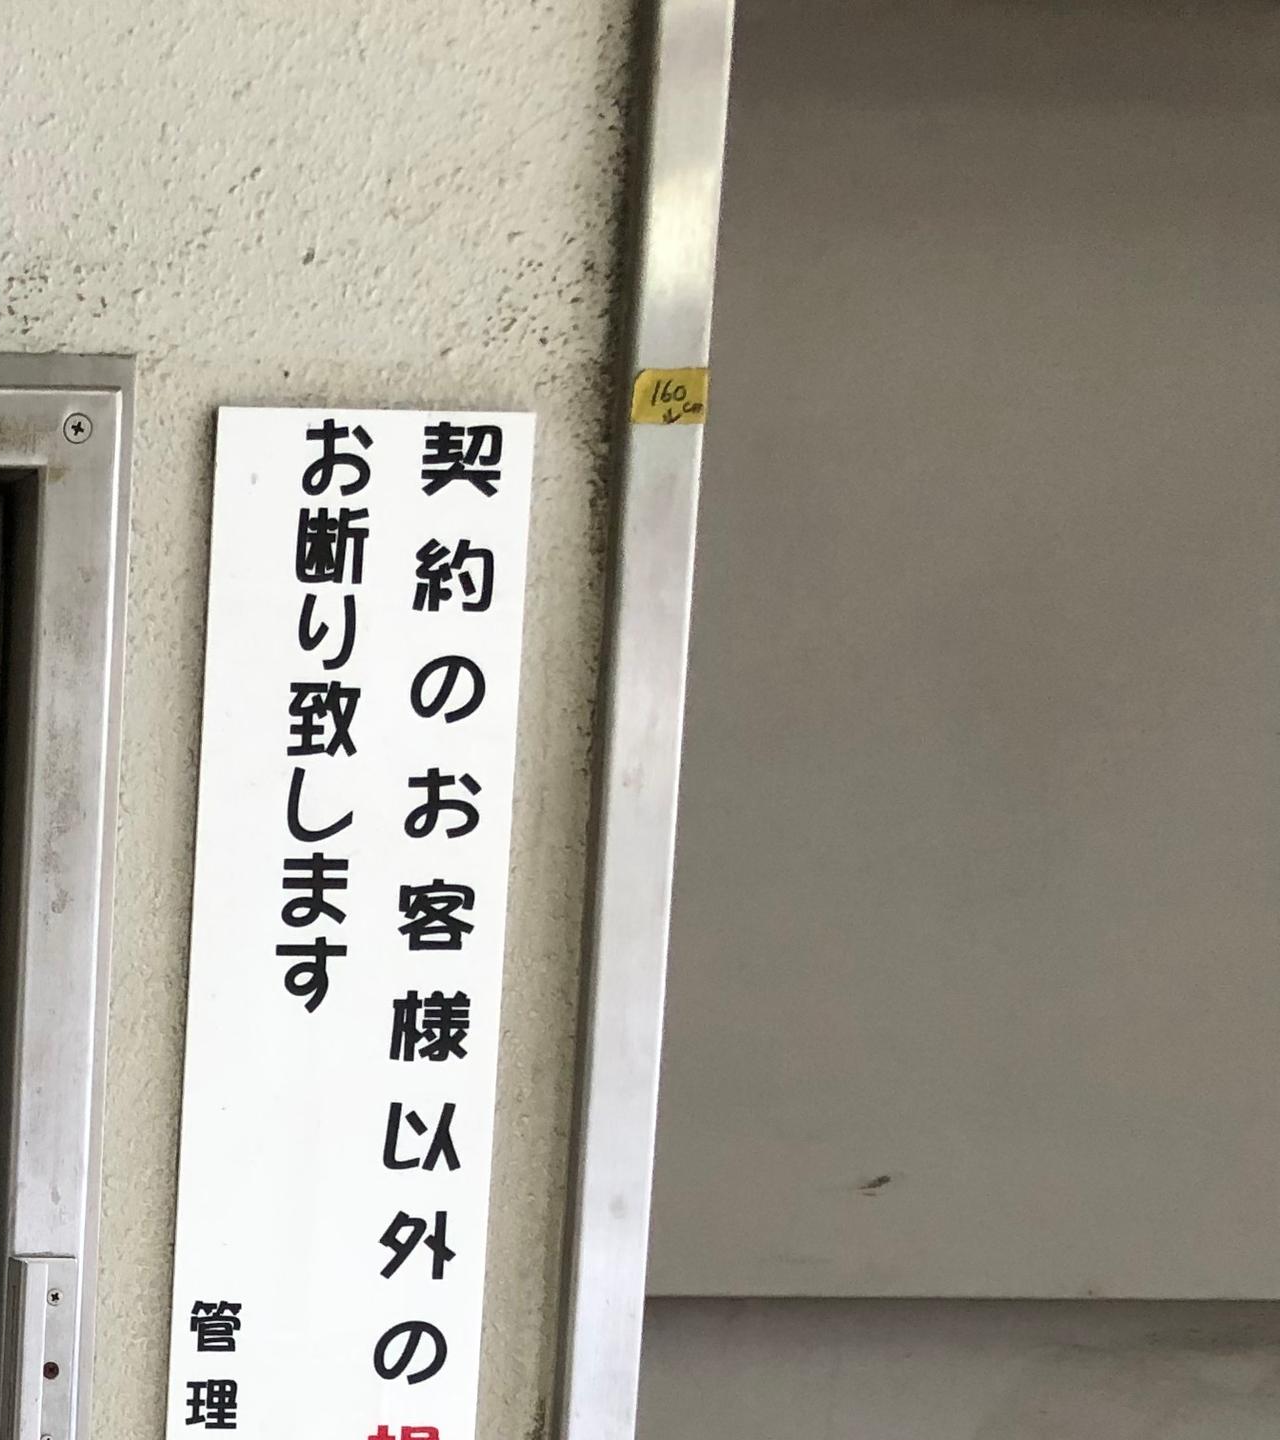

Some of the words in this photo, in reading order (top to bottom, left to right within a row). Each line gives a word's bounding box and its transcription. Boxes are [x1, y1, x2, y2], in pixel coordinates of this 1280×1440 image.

[651, 380, 688, 407] 160
[274, 417, 374, 1014] お断り致します
